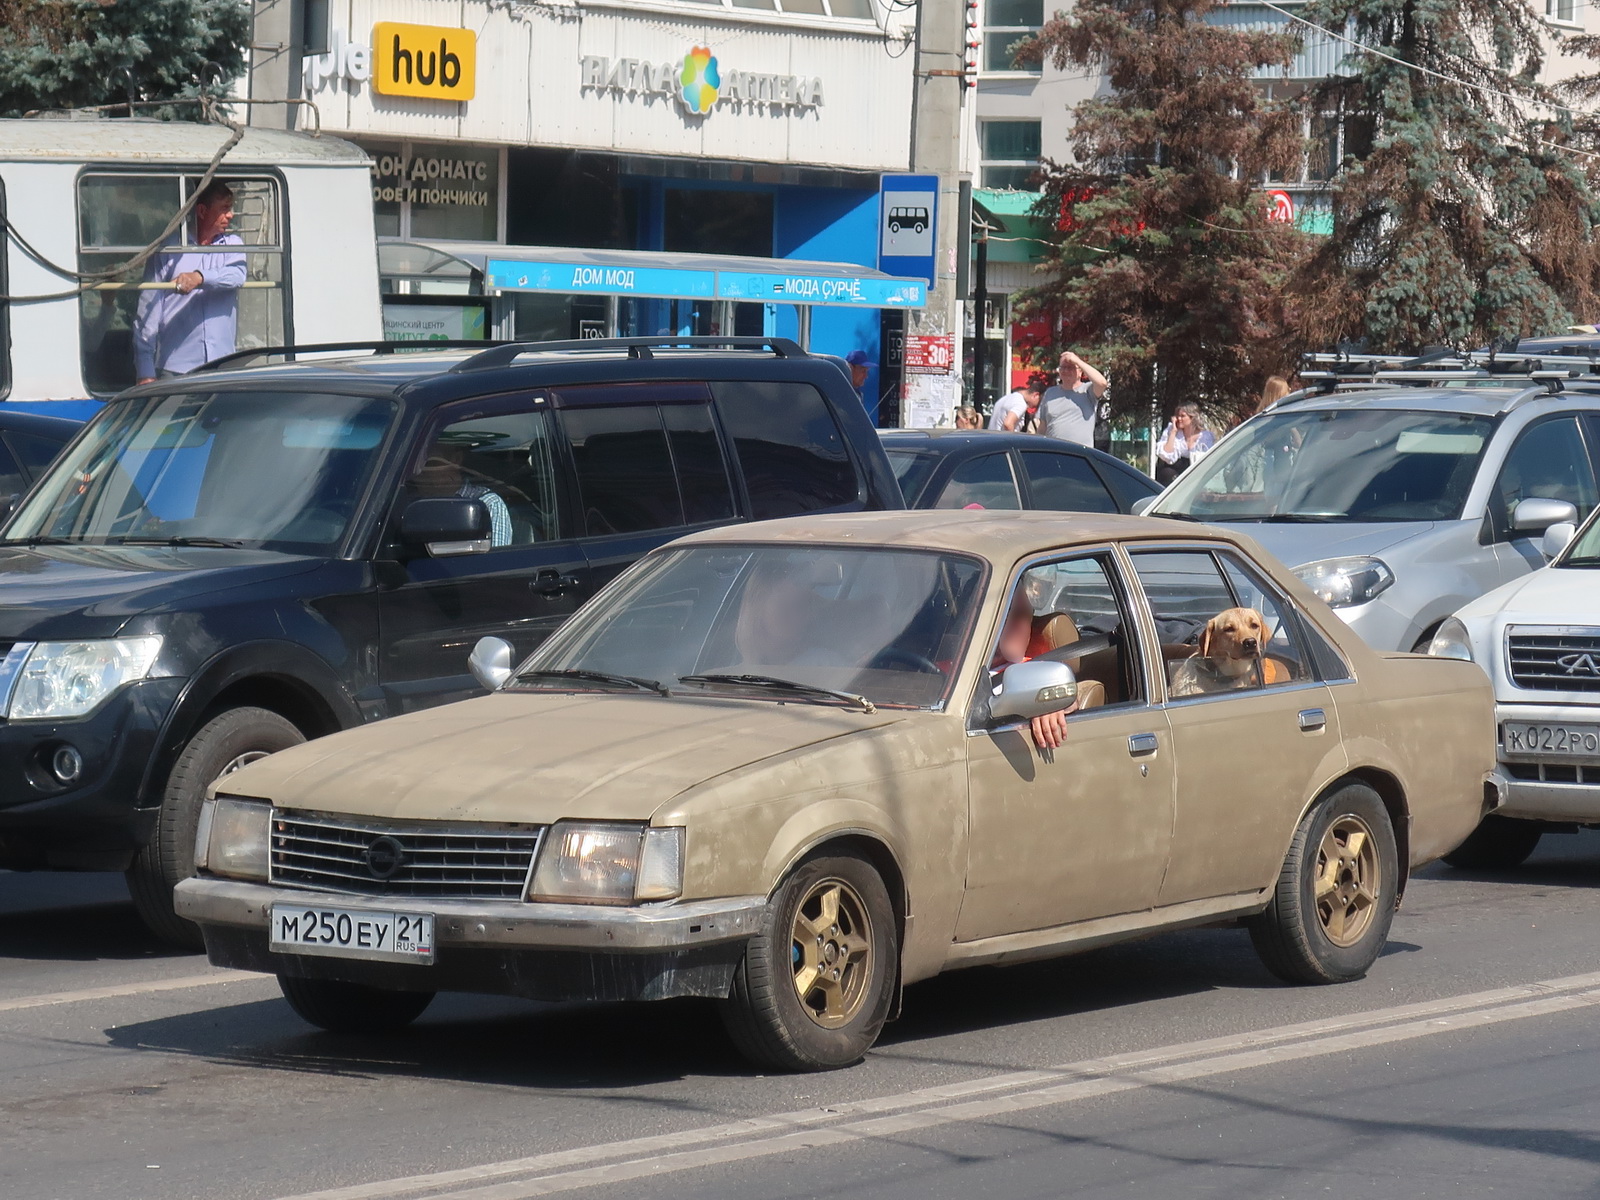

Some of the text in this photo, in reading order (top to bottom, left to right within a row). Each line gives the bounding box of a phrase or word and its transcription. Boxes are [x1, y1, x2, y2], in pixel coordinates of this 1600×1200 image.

[303, 29, 460, 90] ple hub
[580, 54, 825, 106] РИГЛА АПТЕКА
[411, 157, 487, 181] ДОНАТС
[372, 186, 488, 207] ОФЕ И ПОНЧИКИ
[572, 267, 635, 290] ДОМ МОД
[785, 278, 820, 298] МОДА
[385, 331, 425, 341] СТИТУТ
[422, 322, 445, 330] ЦЕНТР
[1511, 726, 1598, 752] К022РО
[282, 911, 423, 948] М250ЕУ 21
[396, 942, 416, 952] RUS
